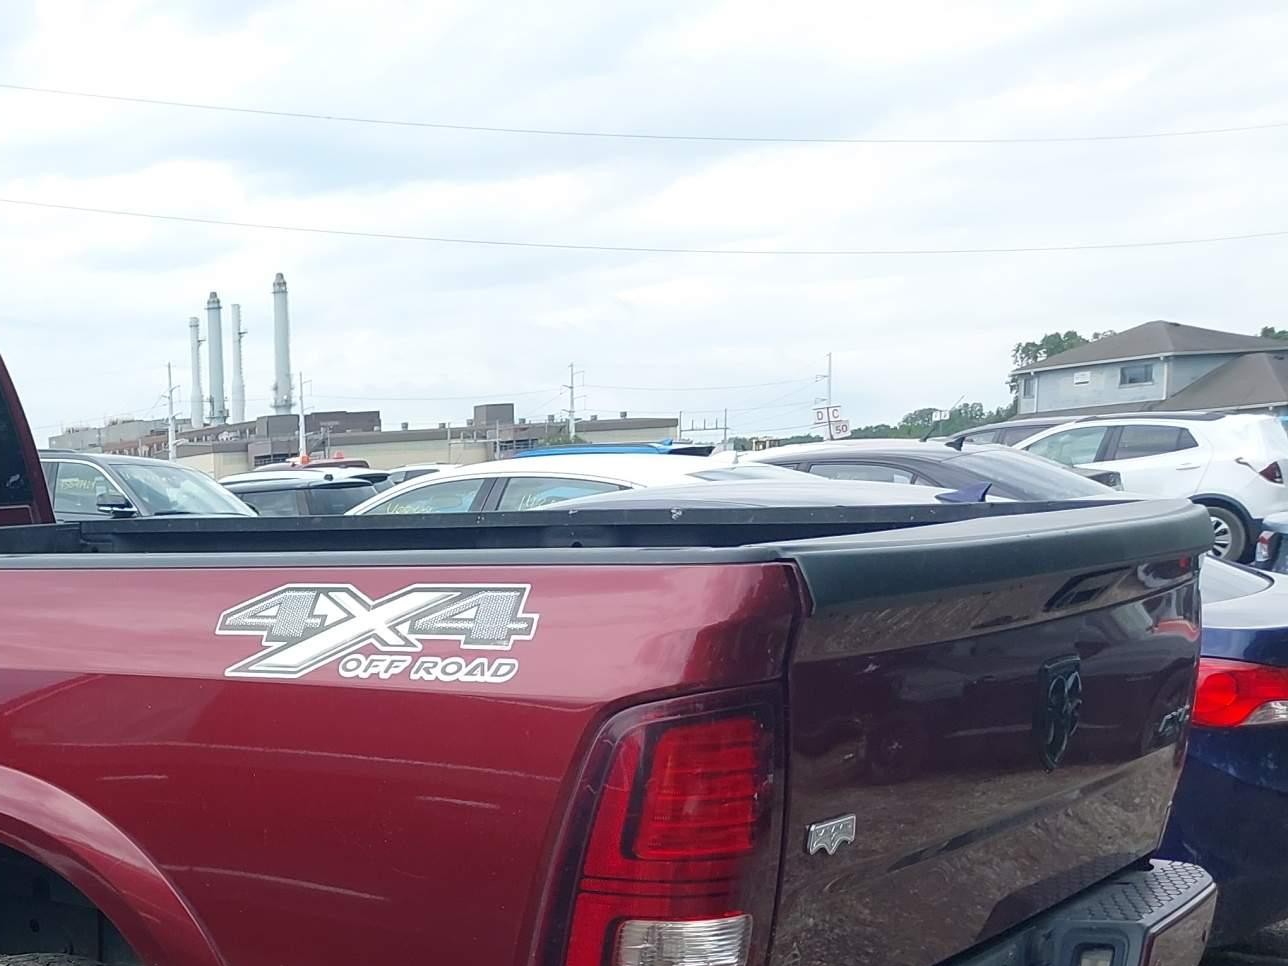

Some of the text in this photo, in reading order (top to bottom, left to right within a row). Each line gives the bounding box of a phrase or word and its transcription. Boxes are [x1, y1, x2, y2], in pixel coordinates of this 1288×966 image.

[831, 408, 840, 419] C
[835, 424, 848, 435] 50
[339, 653, 519, 683] OFF ROAD
